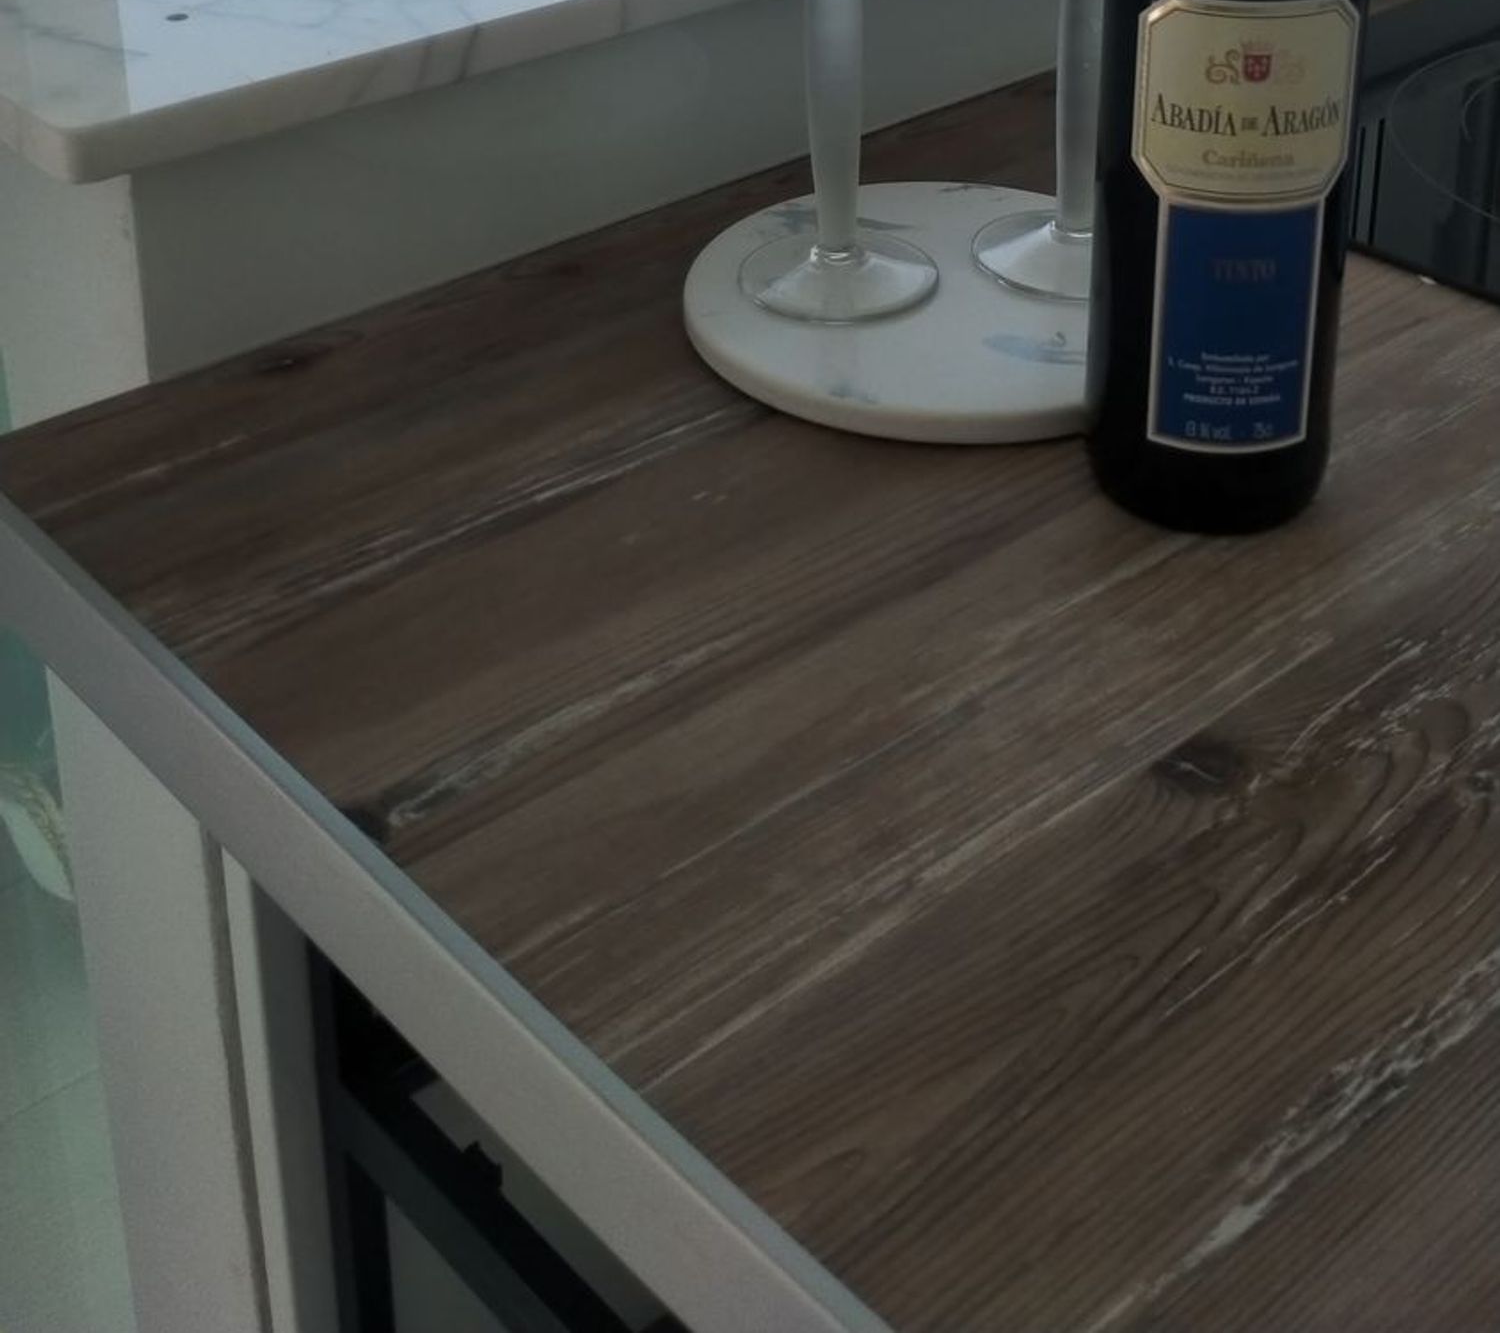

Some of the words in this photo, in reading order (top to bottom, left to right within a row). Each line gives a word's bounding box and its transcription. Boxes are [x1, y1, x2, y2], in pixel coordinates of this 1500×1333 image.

[1151, 93, 1236, 136] ABADÍA
[1241, 116, 1259, 131] DE
[1261, 96, 1342, 136] ARAGÓN
[1202, 149, 1295, 169] Cariñena
[1212, 258, 1277, 282] TINTO
